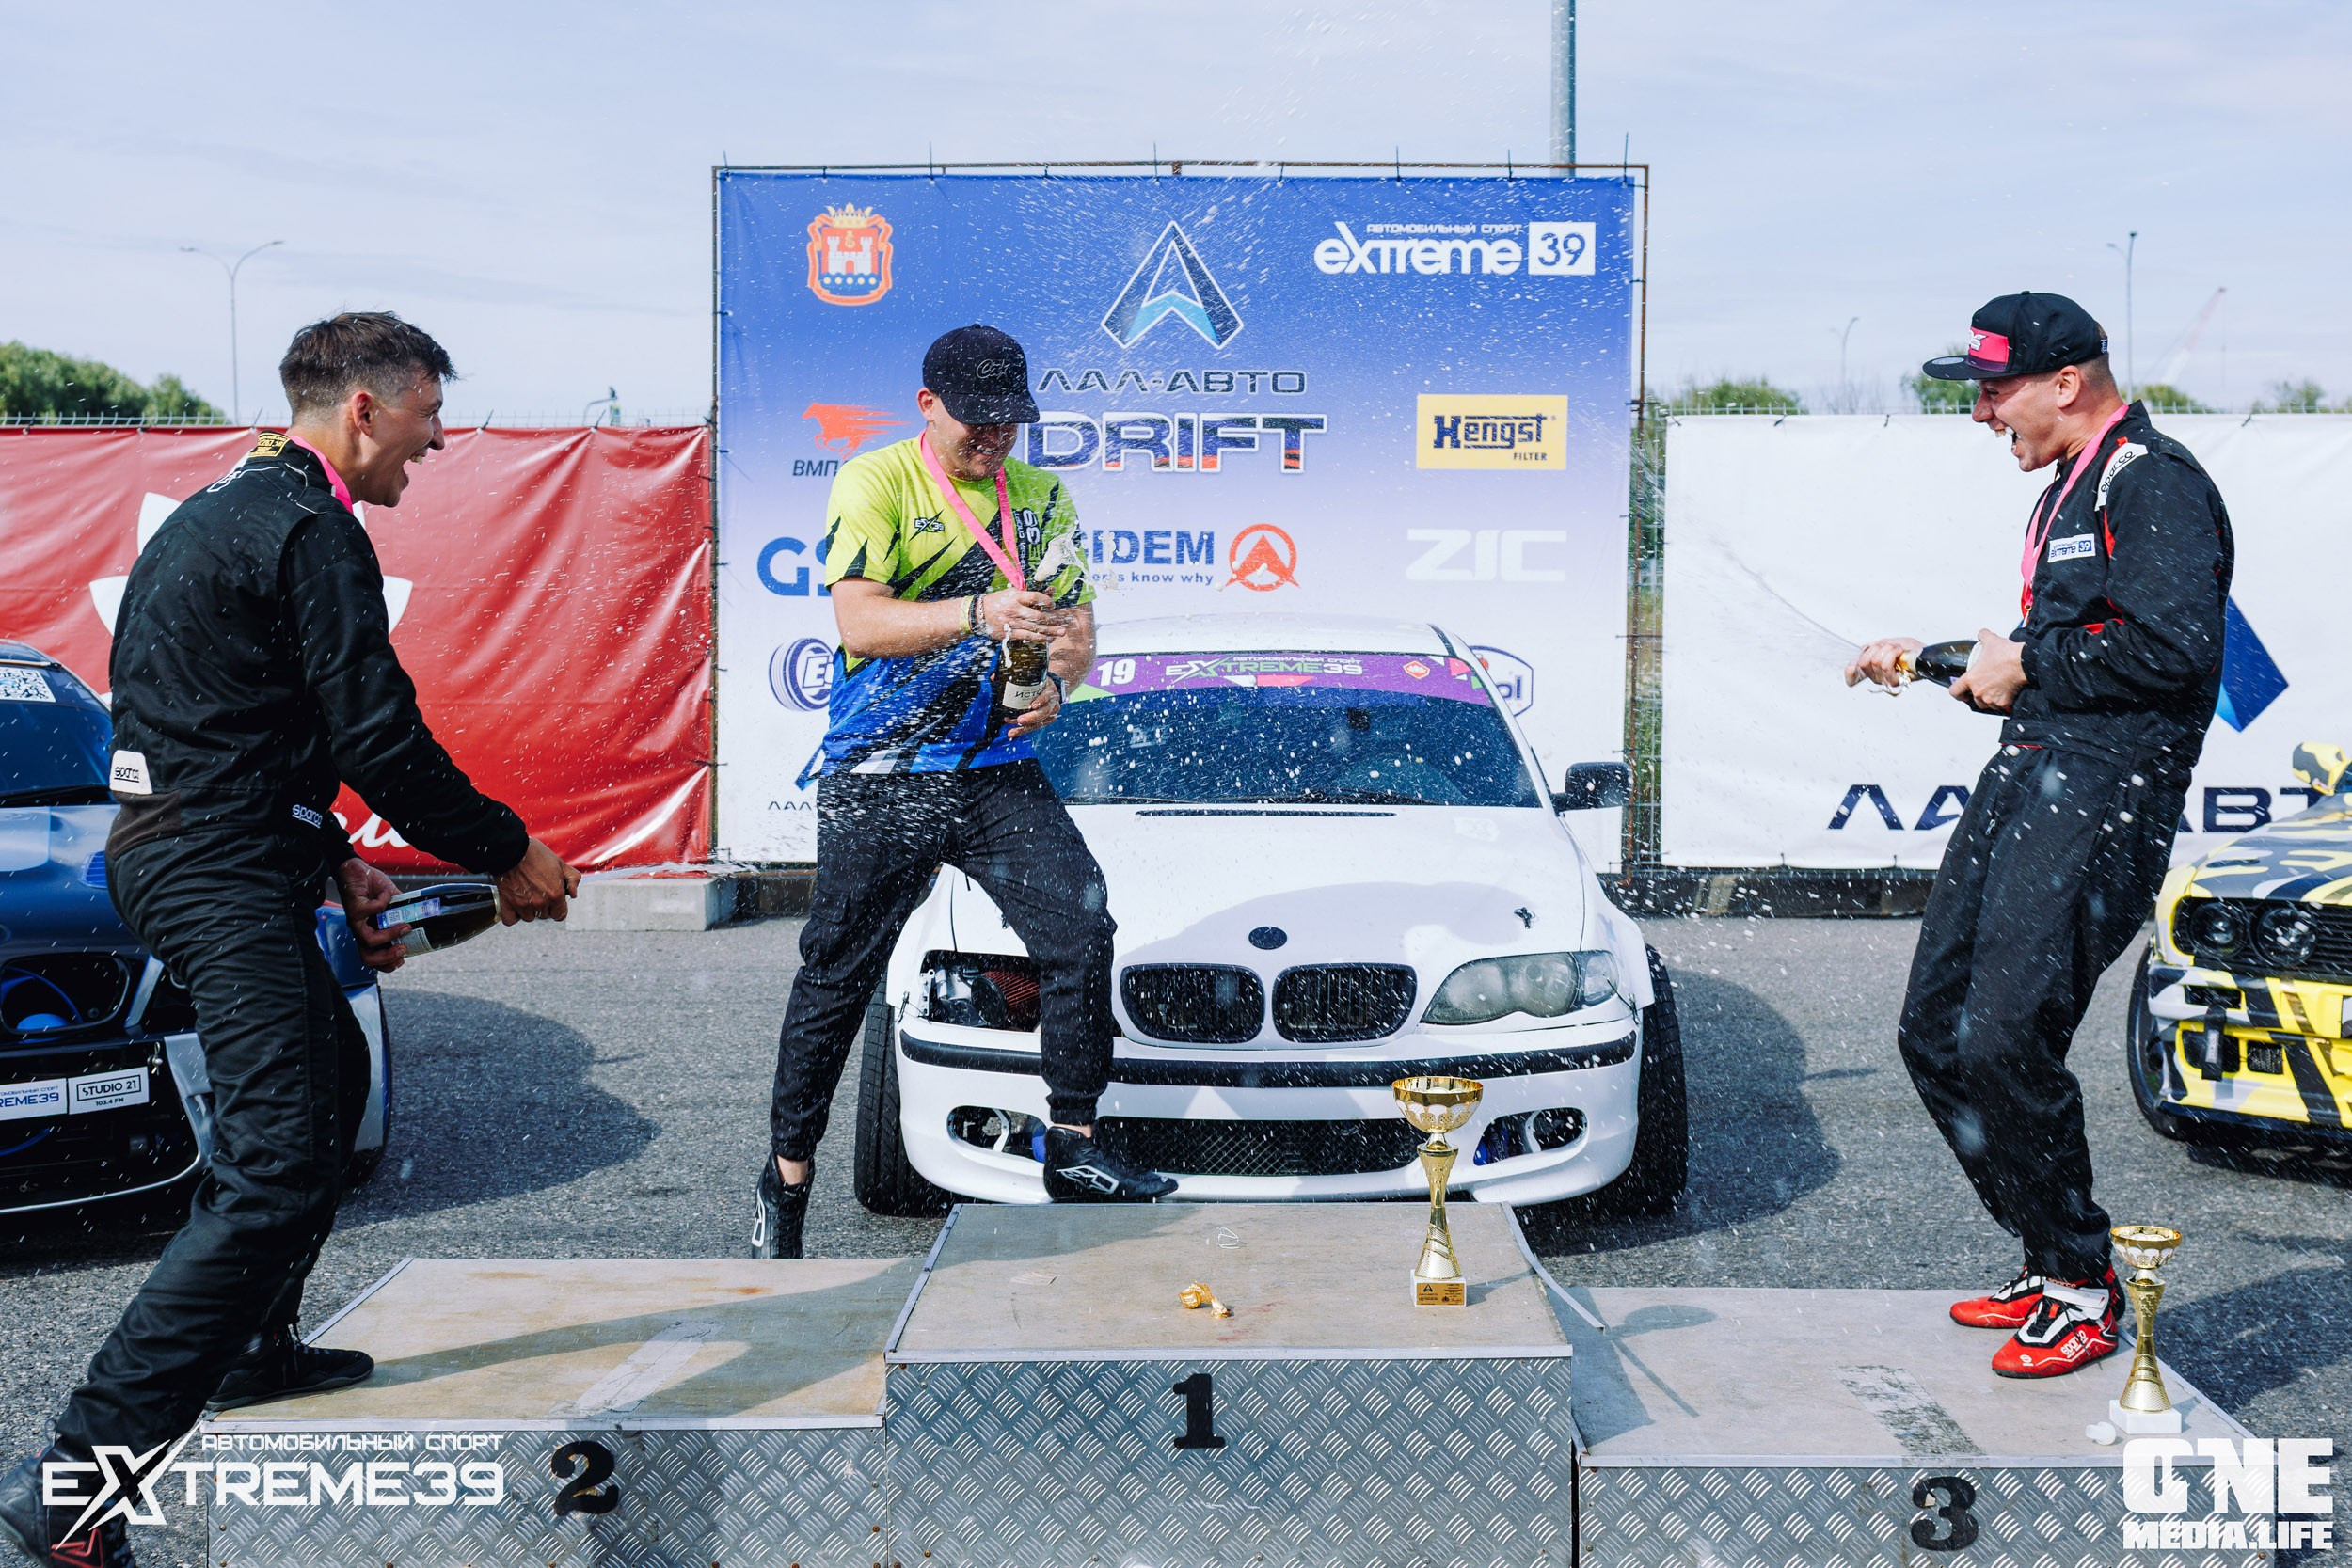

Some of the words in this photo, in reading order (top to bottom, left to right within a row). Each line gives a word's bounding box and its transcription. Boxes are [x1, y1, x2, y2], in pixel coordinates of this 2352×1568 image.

[1367, 222, 1476, 234] АВТОМОБИЛЬНЫЙ
[1481, 223, 1523, 234] СПОРТ
[1537, 232, 1586, 267] 39
[1036, 368, 1308, 395] ЛАЛ-АВТО
[1025, 411, 1327, 474] DRIFT
[1434, 413, 1548, 449] Hengst
[792, 459, 849, 477] ВМП
[1513, 452, 1548, 461] FILTER
[1406, 529, 1567, 582] ZIC
[1132, 571, 1174, 583] know
[1181, 571, 1214, 586] why
[1097, 658, 1136, 687] 19
[1166, 656, 1363, 681] EXTREME39
[292, 804, 324, 828] sparco
[82, 1083, 123, 1096] STUDIO
[126, 1080, 136, 1090] 21
[95, 1098, 113, 1106] 103.4
[2060, 1329, 2088, 1359] sparco
[1173, 1373, 1226, 1449] 1
[550, 1440, 619, 1515] 2
[1911, 1476, 1977, 1552] 3
